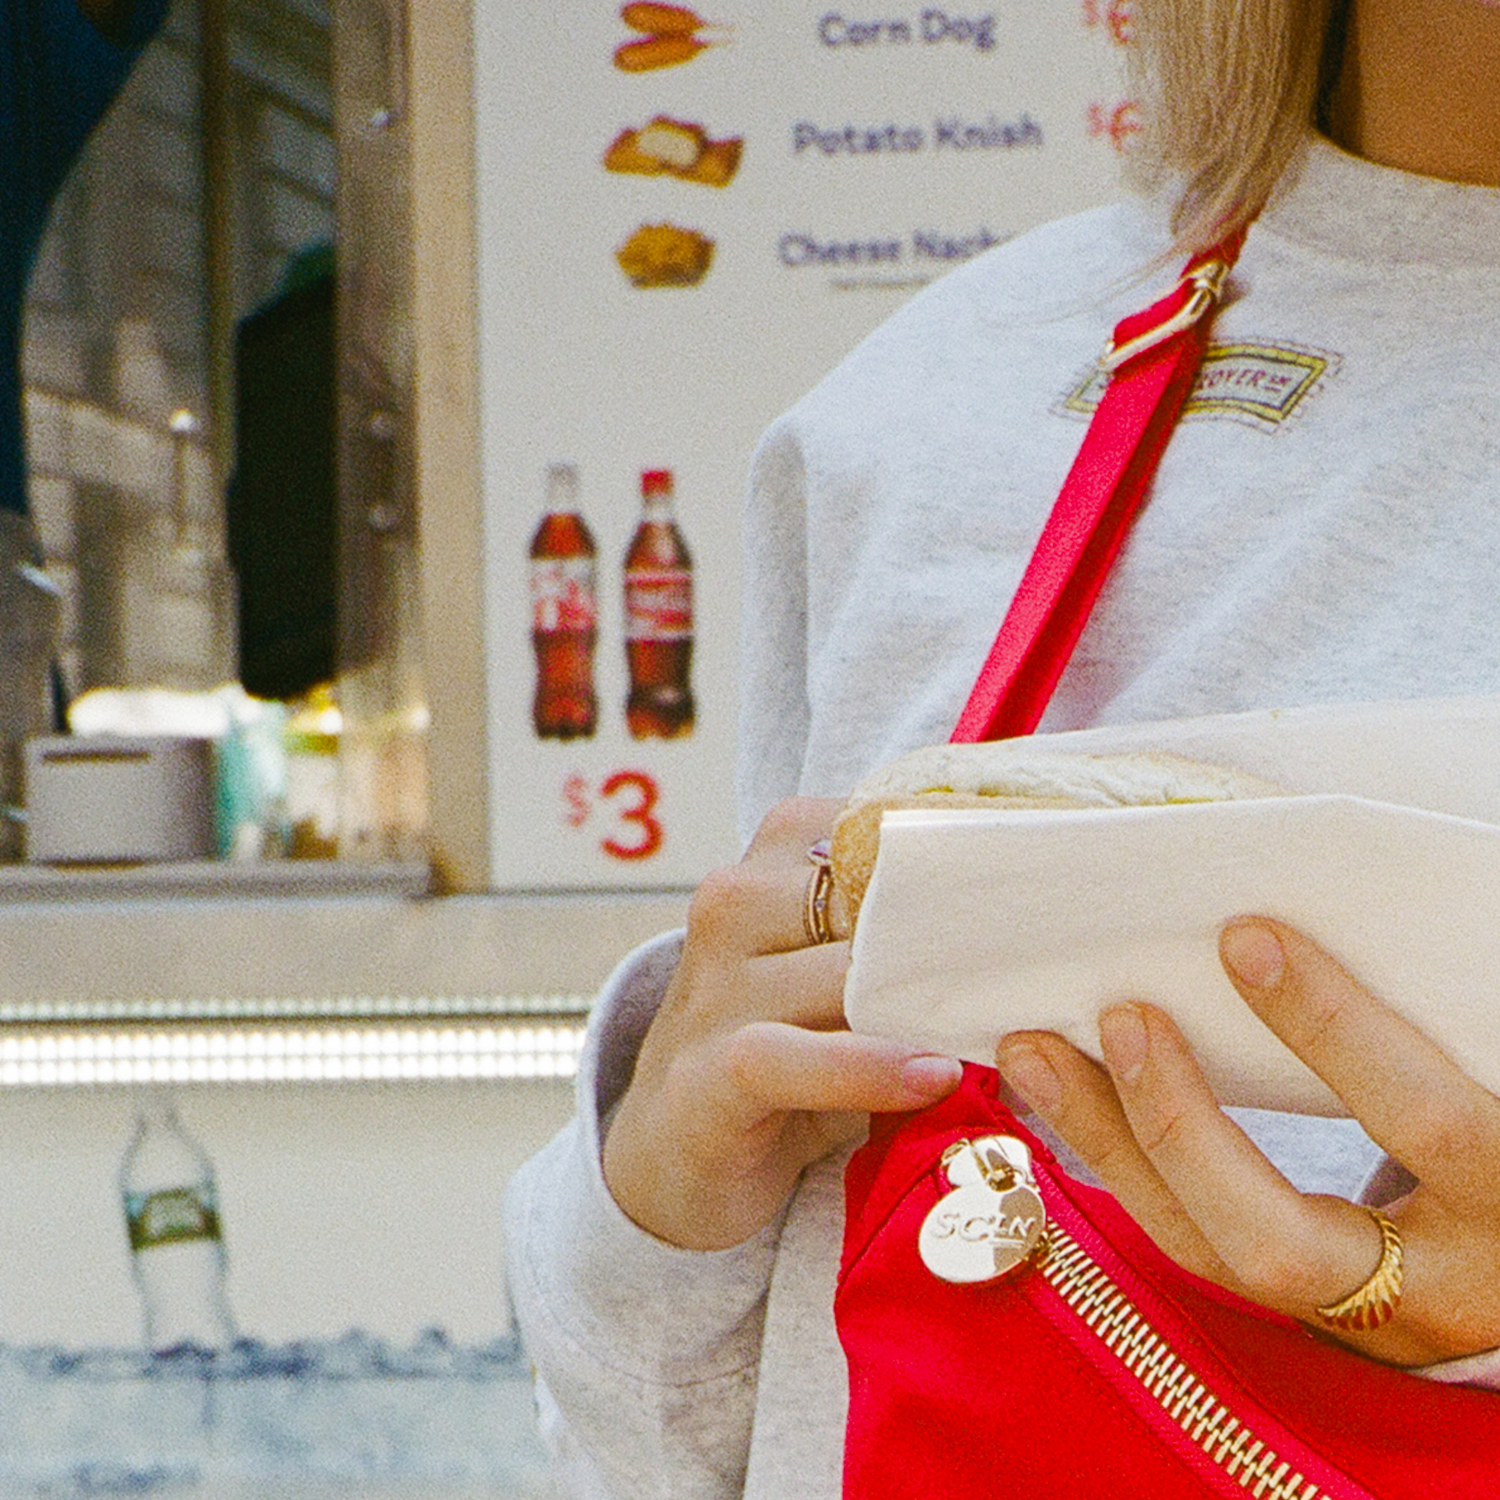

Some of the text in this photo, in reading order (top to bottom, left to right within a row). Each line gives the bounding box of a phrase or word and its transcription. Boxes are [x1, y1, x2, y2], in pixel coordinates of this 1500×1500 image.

[817, 8, 999, 52] Corn Dog
[791, 112, 1045, 154] Potato Knish
[778, 232, 902, 267] Cheese
[562, 768, 664, 862] $3
[931, 1212, 1037, 1248] SCLN
